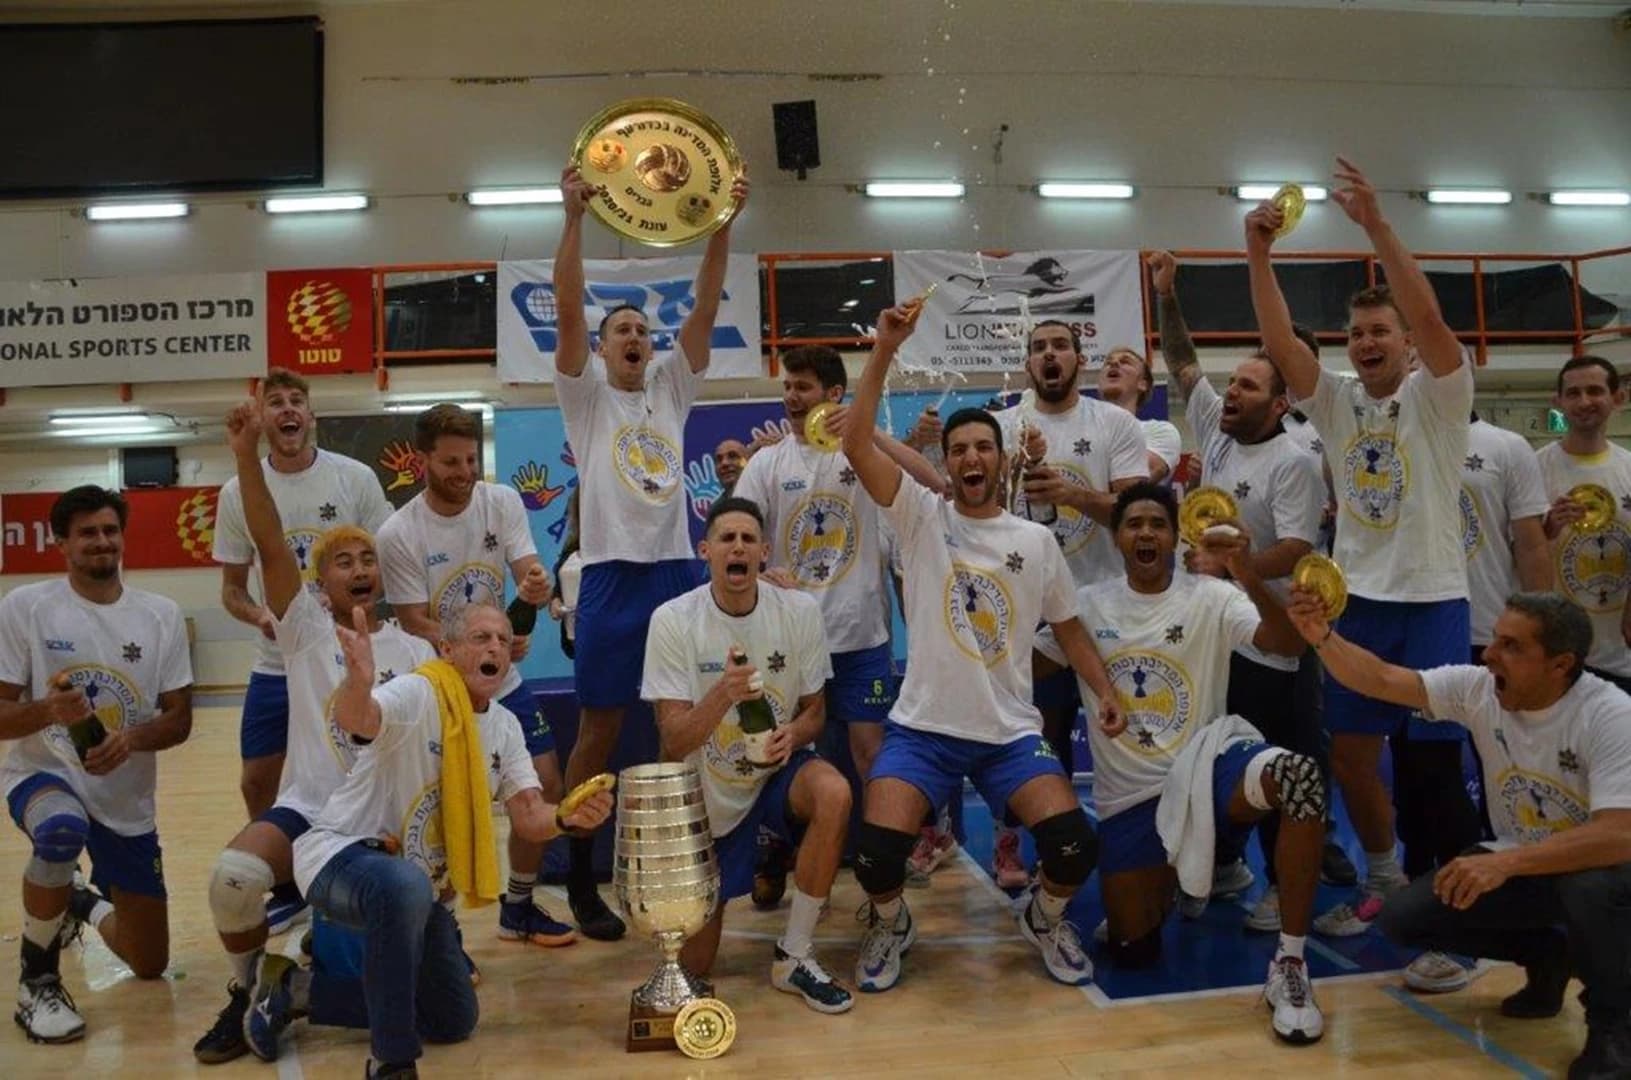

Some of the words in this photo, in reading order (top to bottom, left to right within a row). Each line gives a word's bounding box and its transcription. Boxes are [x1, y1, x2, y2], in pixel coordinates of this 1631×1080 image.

[674, 126, 711, 158] המדינה
[707, 157, 722, 195] אלופת
[72, 302, 179, 325] הספורט
[187, 298, 254, 320] מרכז
[69, 337, 157, 359] SPORTS
[164, 334, 251, 354] CENTER
[298, 347, 342, 365] טוטו
